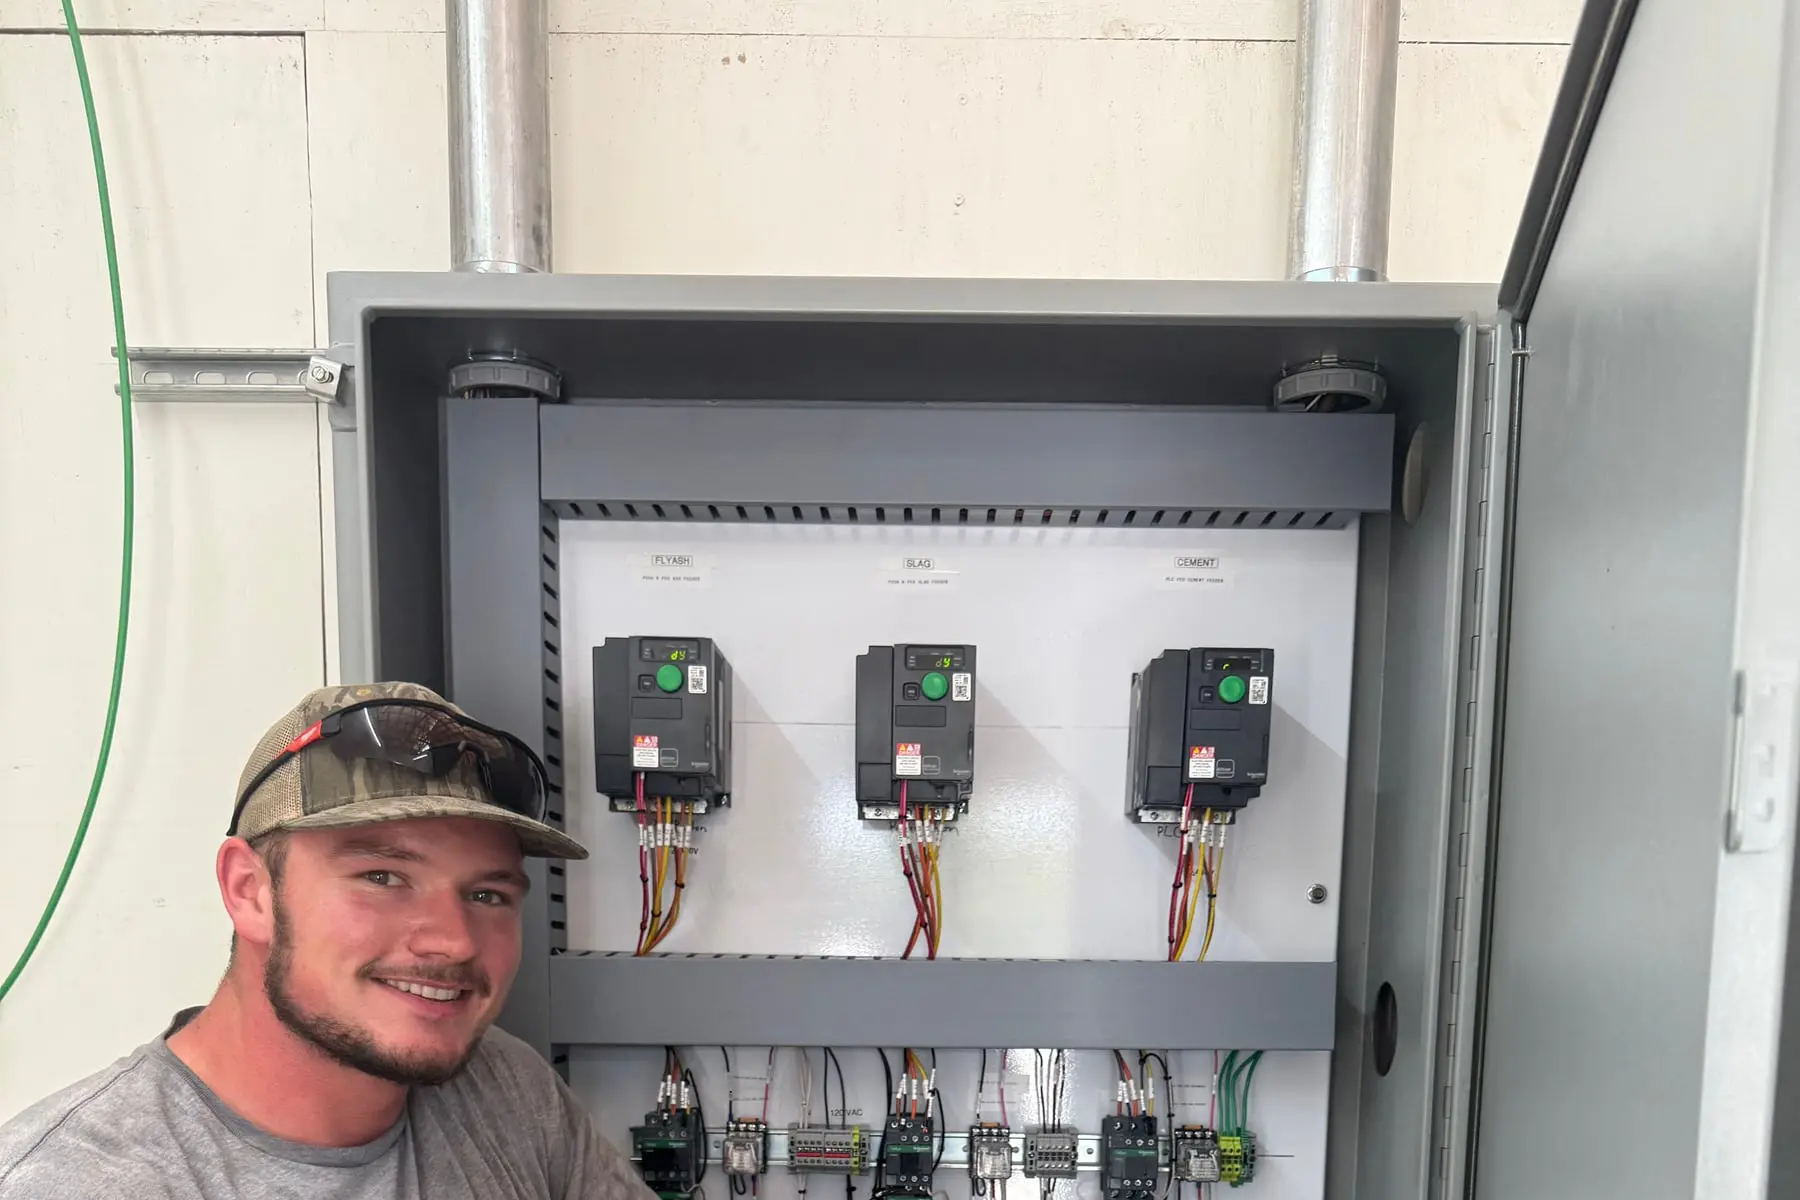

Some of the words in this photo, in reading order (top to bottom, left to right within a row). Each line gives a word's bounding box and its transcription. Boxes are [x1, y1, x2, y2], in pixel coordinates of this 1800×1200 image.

[655, 556, 690, 565] FLYASH
[906, 559, 931, 568] SLAG
[1176, 558, 1215, 567] CEMENT
